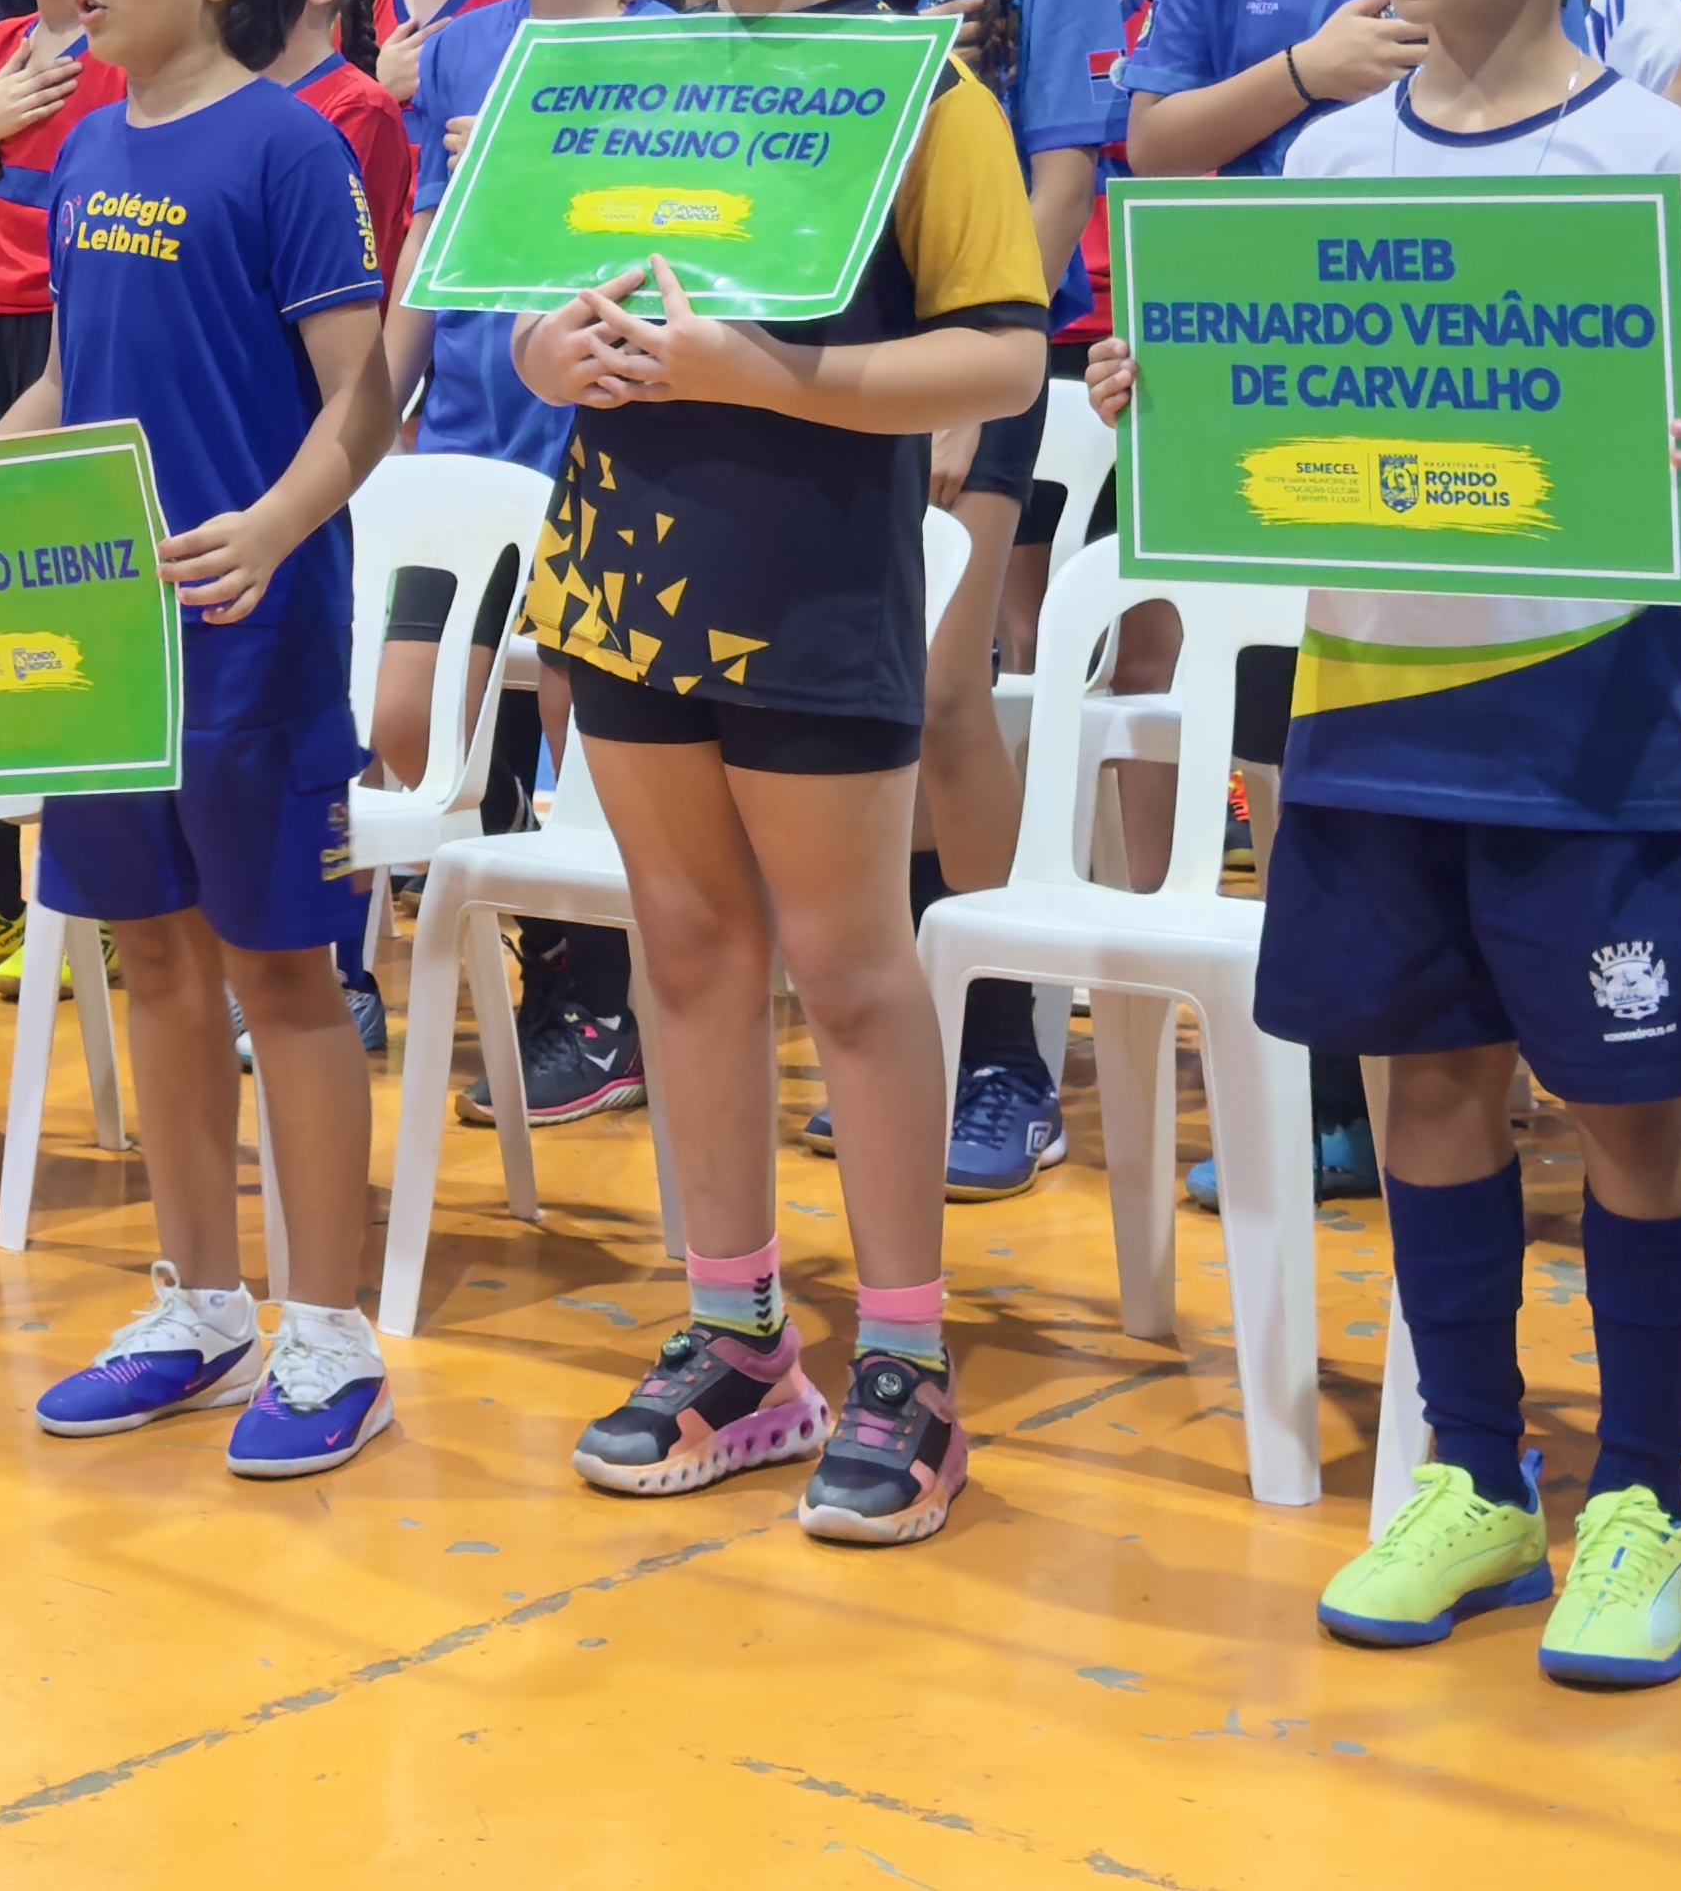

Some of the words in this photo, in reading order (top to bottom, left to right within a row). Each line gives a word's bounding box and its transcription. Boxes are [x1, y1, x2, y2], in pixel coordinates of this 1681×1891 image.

[531, 84, 668, 114] CENTRO
[672, 84, 886, 117] INTEGRADO
[551, 127, 599, 155] DE
[602, 129, 739, 160] ENSINO
[746, 131, 830, 168] (CIE)
[86, 191, 187, 227] Colégio
[77, 221, 180, 262] Leibniz
[1317, 239, 1456, 283] EMEB
[1142, 301, 1393, 347] BERNARDO
[1407, 291, 1656, 350] VENÂNCIO
[1231, 363, 1289, 405] DE
[1298, 364, 1561, 412] CARVALHO
[1296, 462, 1359, 474] SEMECEL
[1425, 471, 1497, 488] RONDO
[1425, 487, 1511, 507] NÓPOLIS
[18, 539, 140, 589] LEIBNIZ
